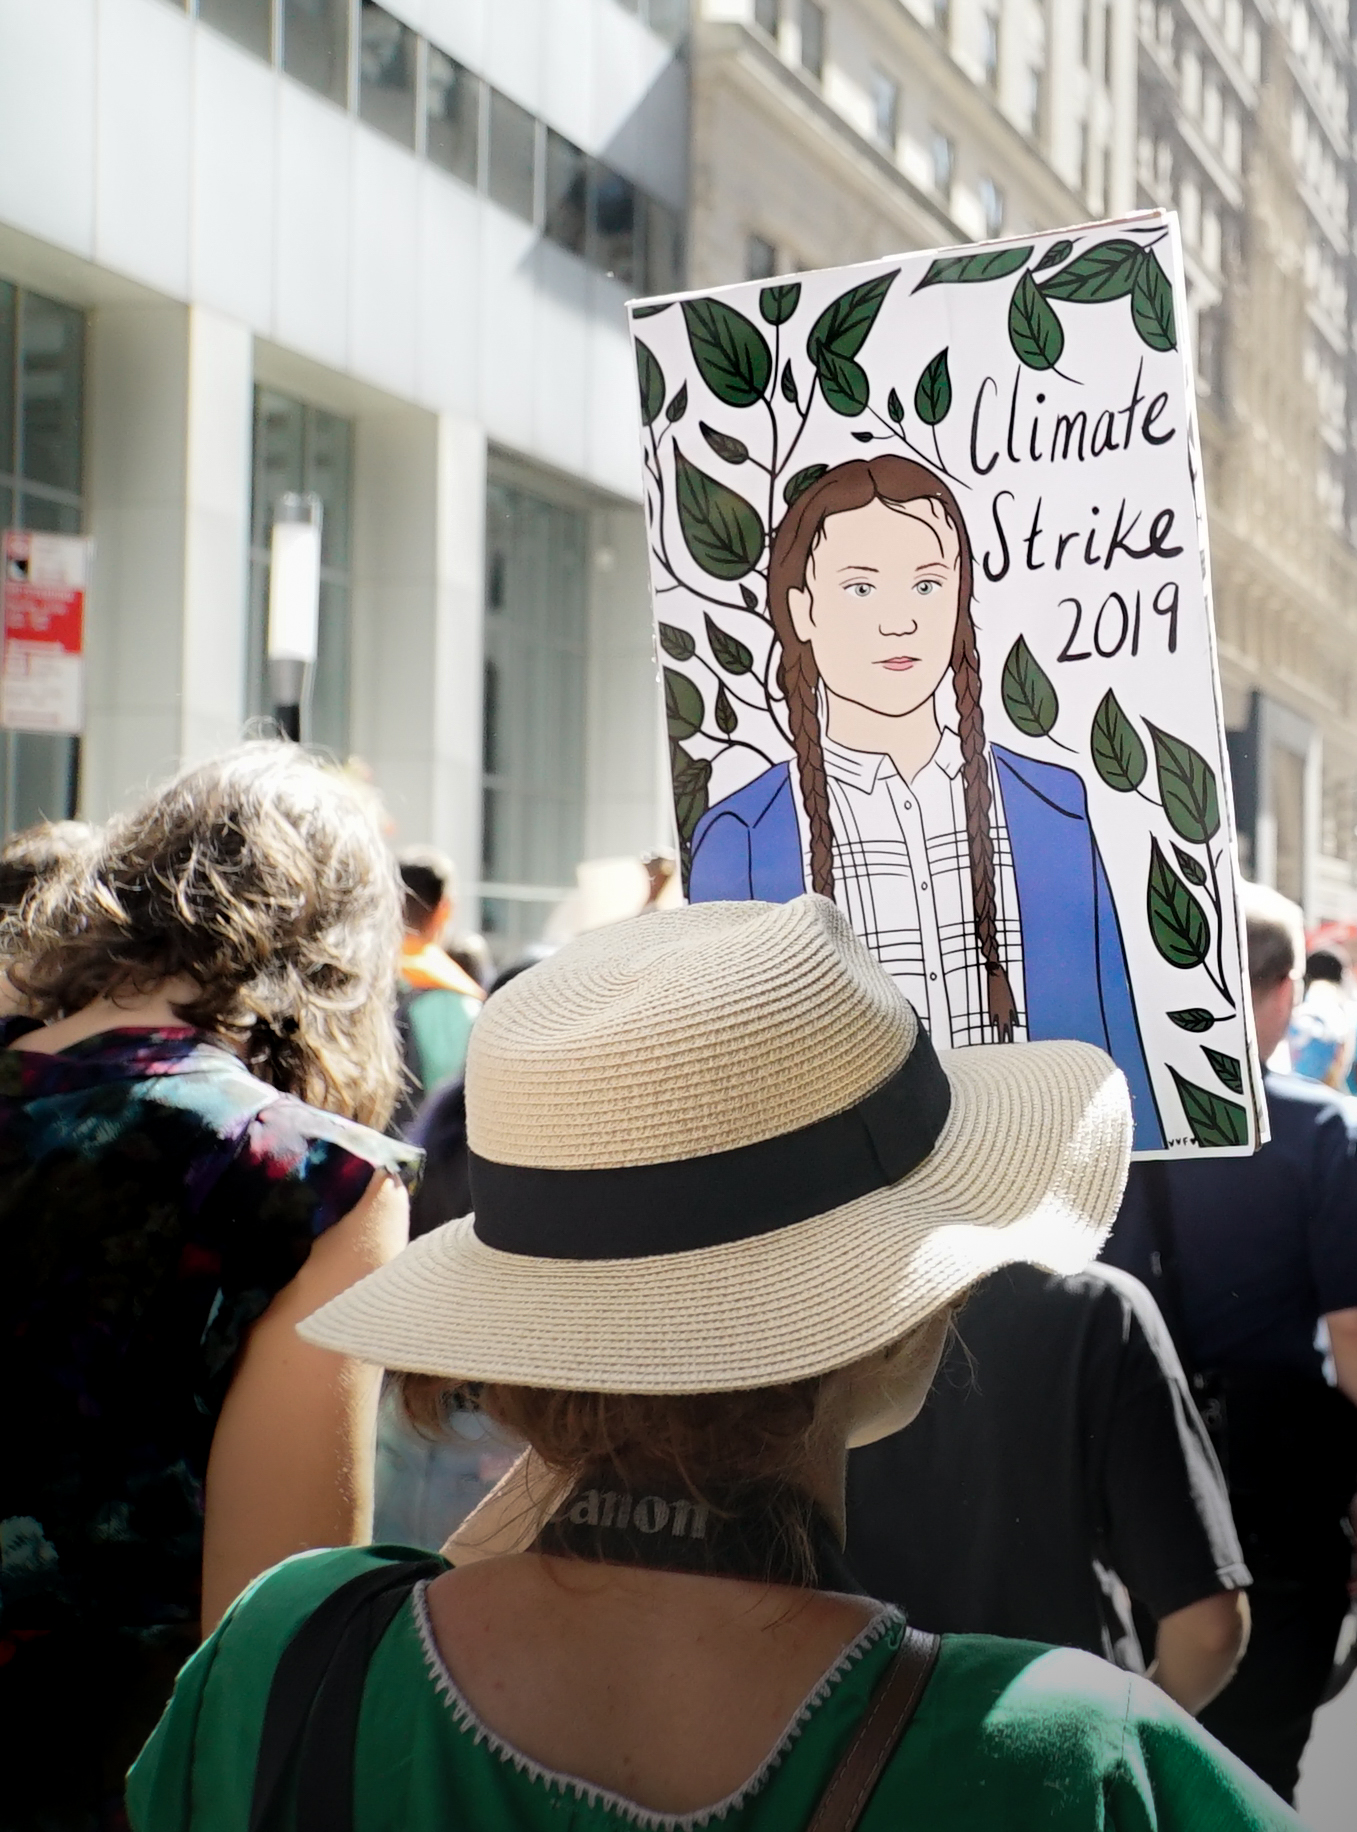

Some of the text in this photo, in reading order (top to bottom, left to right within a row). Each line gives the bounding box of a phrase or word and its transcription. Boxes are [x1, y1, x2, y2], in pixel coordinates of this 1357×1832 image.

[970, 355, 1176, 475] Climate
[982, 490, 1184, 582] Strike
[1057, 581, 1179, 663] 2019
[555, 1489, 709, 1540] anon
